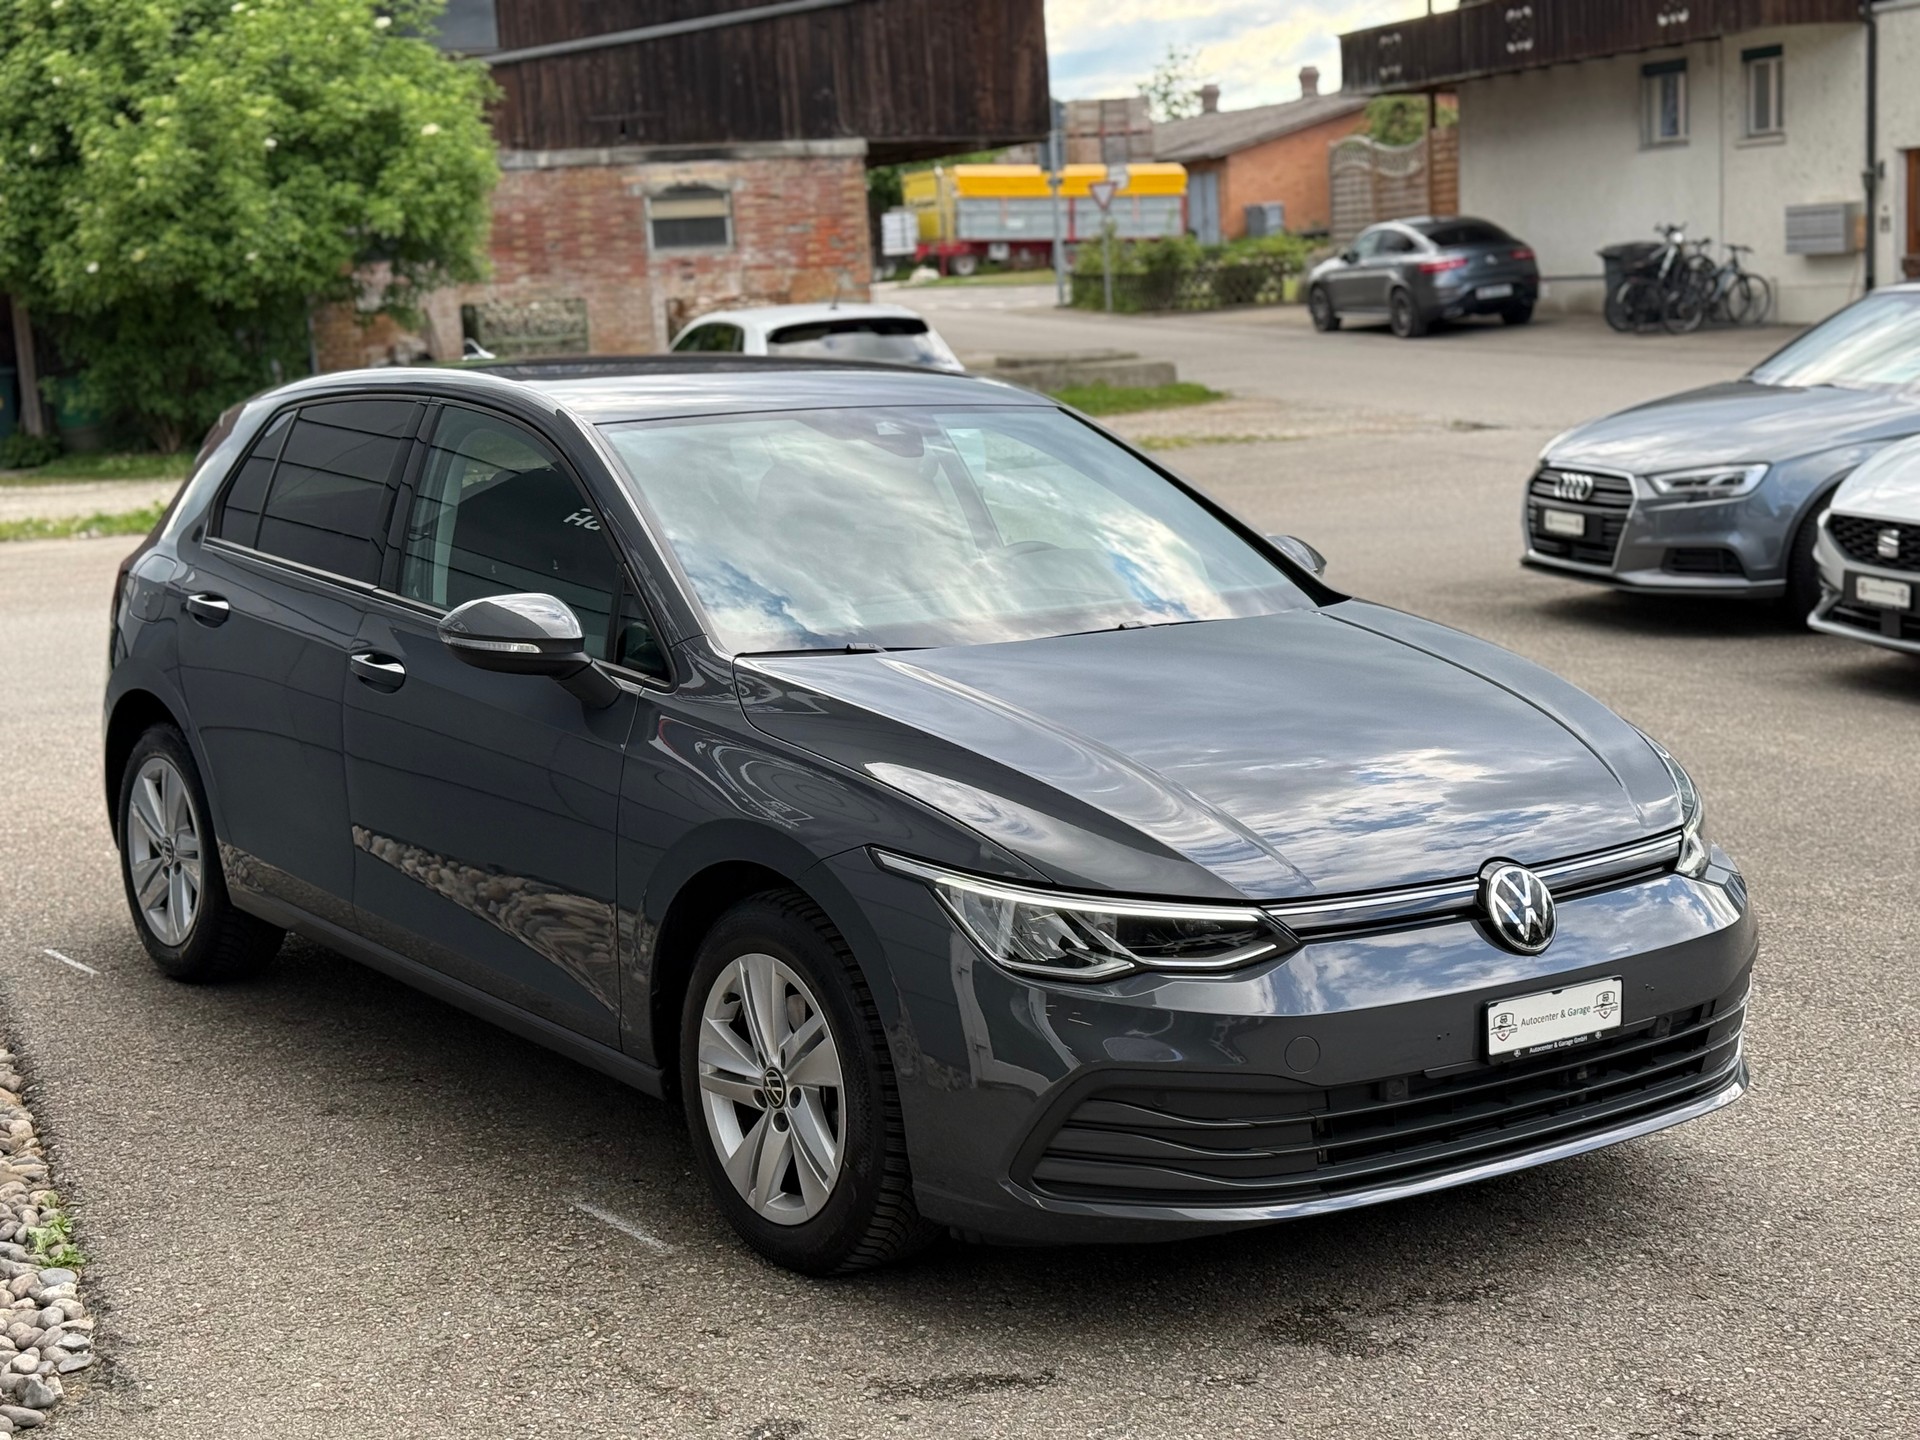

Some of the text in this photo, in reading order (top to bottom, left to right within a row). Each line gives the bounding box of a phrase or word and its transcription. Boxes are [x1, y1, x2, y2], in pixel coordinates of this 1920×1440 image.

[1488, 865, 1557, 951] VW
[1520, 1013, 1559, 1027] Autocenter
[1560, 1009, 1566, 1019] &
[1567, 1006, 1591, 1017] Garage
